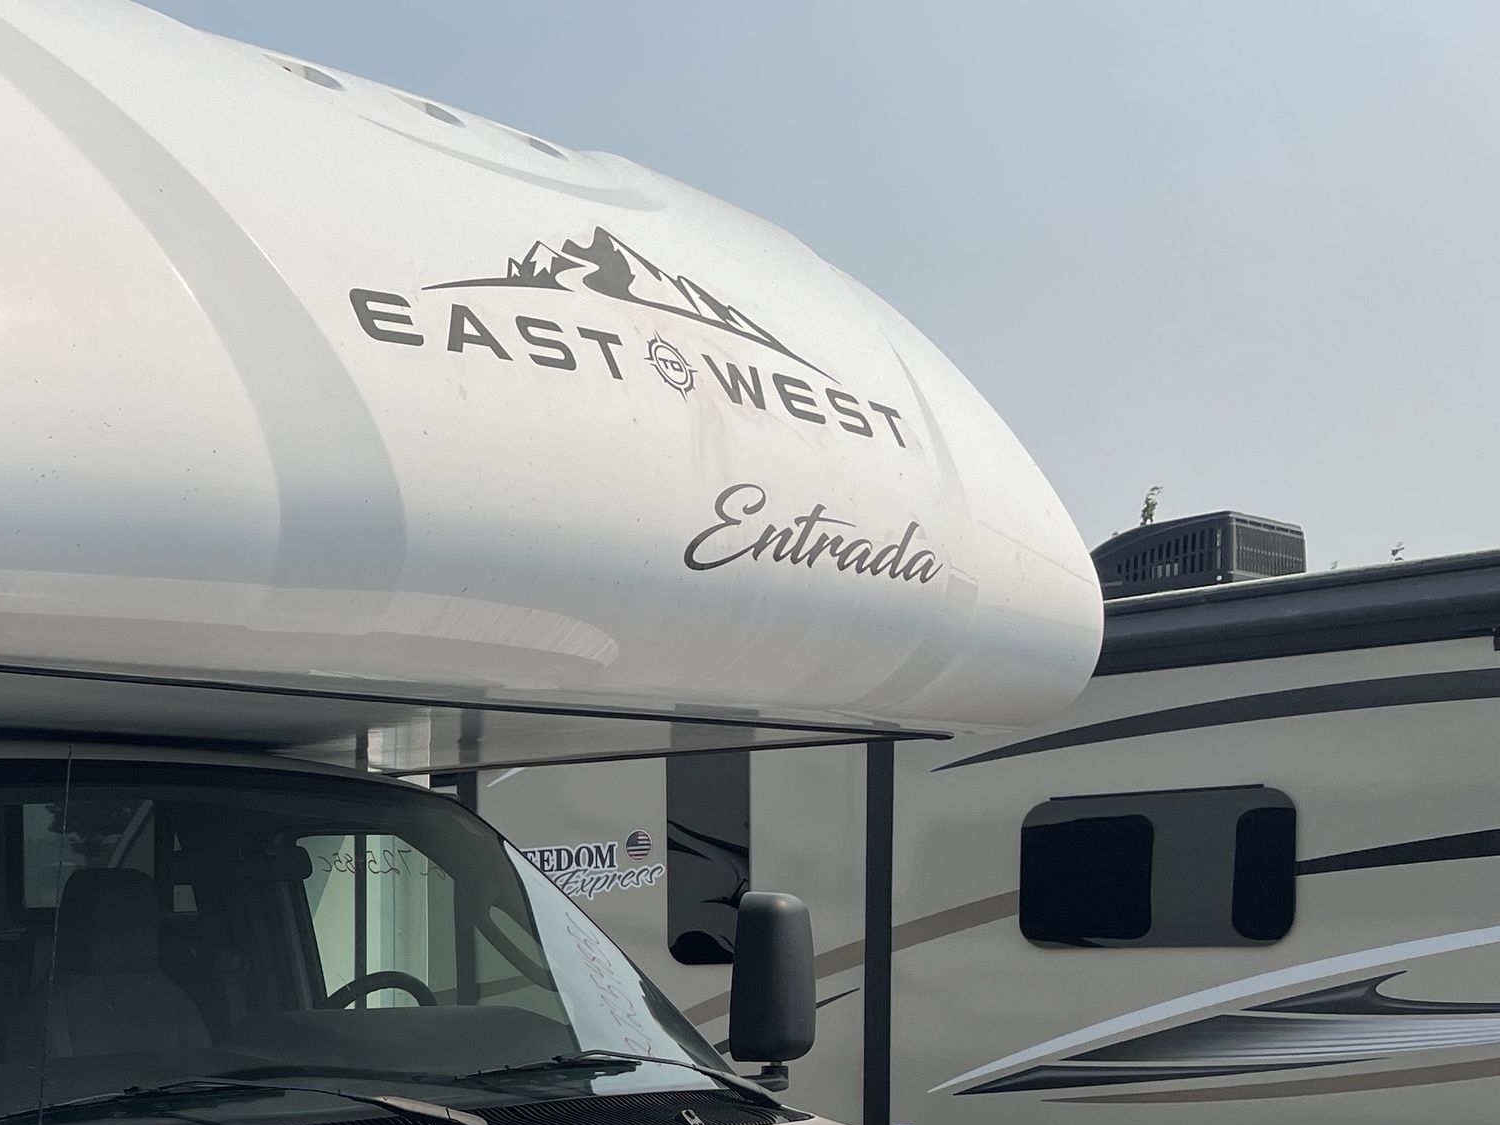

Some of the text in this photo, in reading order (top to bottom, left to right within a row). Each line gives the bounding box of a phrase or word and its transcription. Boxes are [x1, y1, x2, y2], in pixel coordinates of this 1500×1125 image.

[349, 288, 907, 448] EAST TO WEST
[683, 482, 941, 584] Entrada
[521, 843, 617, 872] EEDOM
[554, 865, 663, 898] Express
